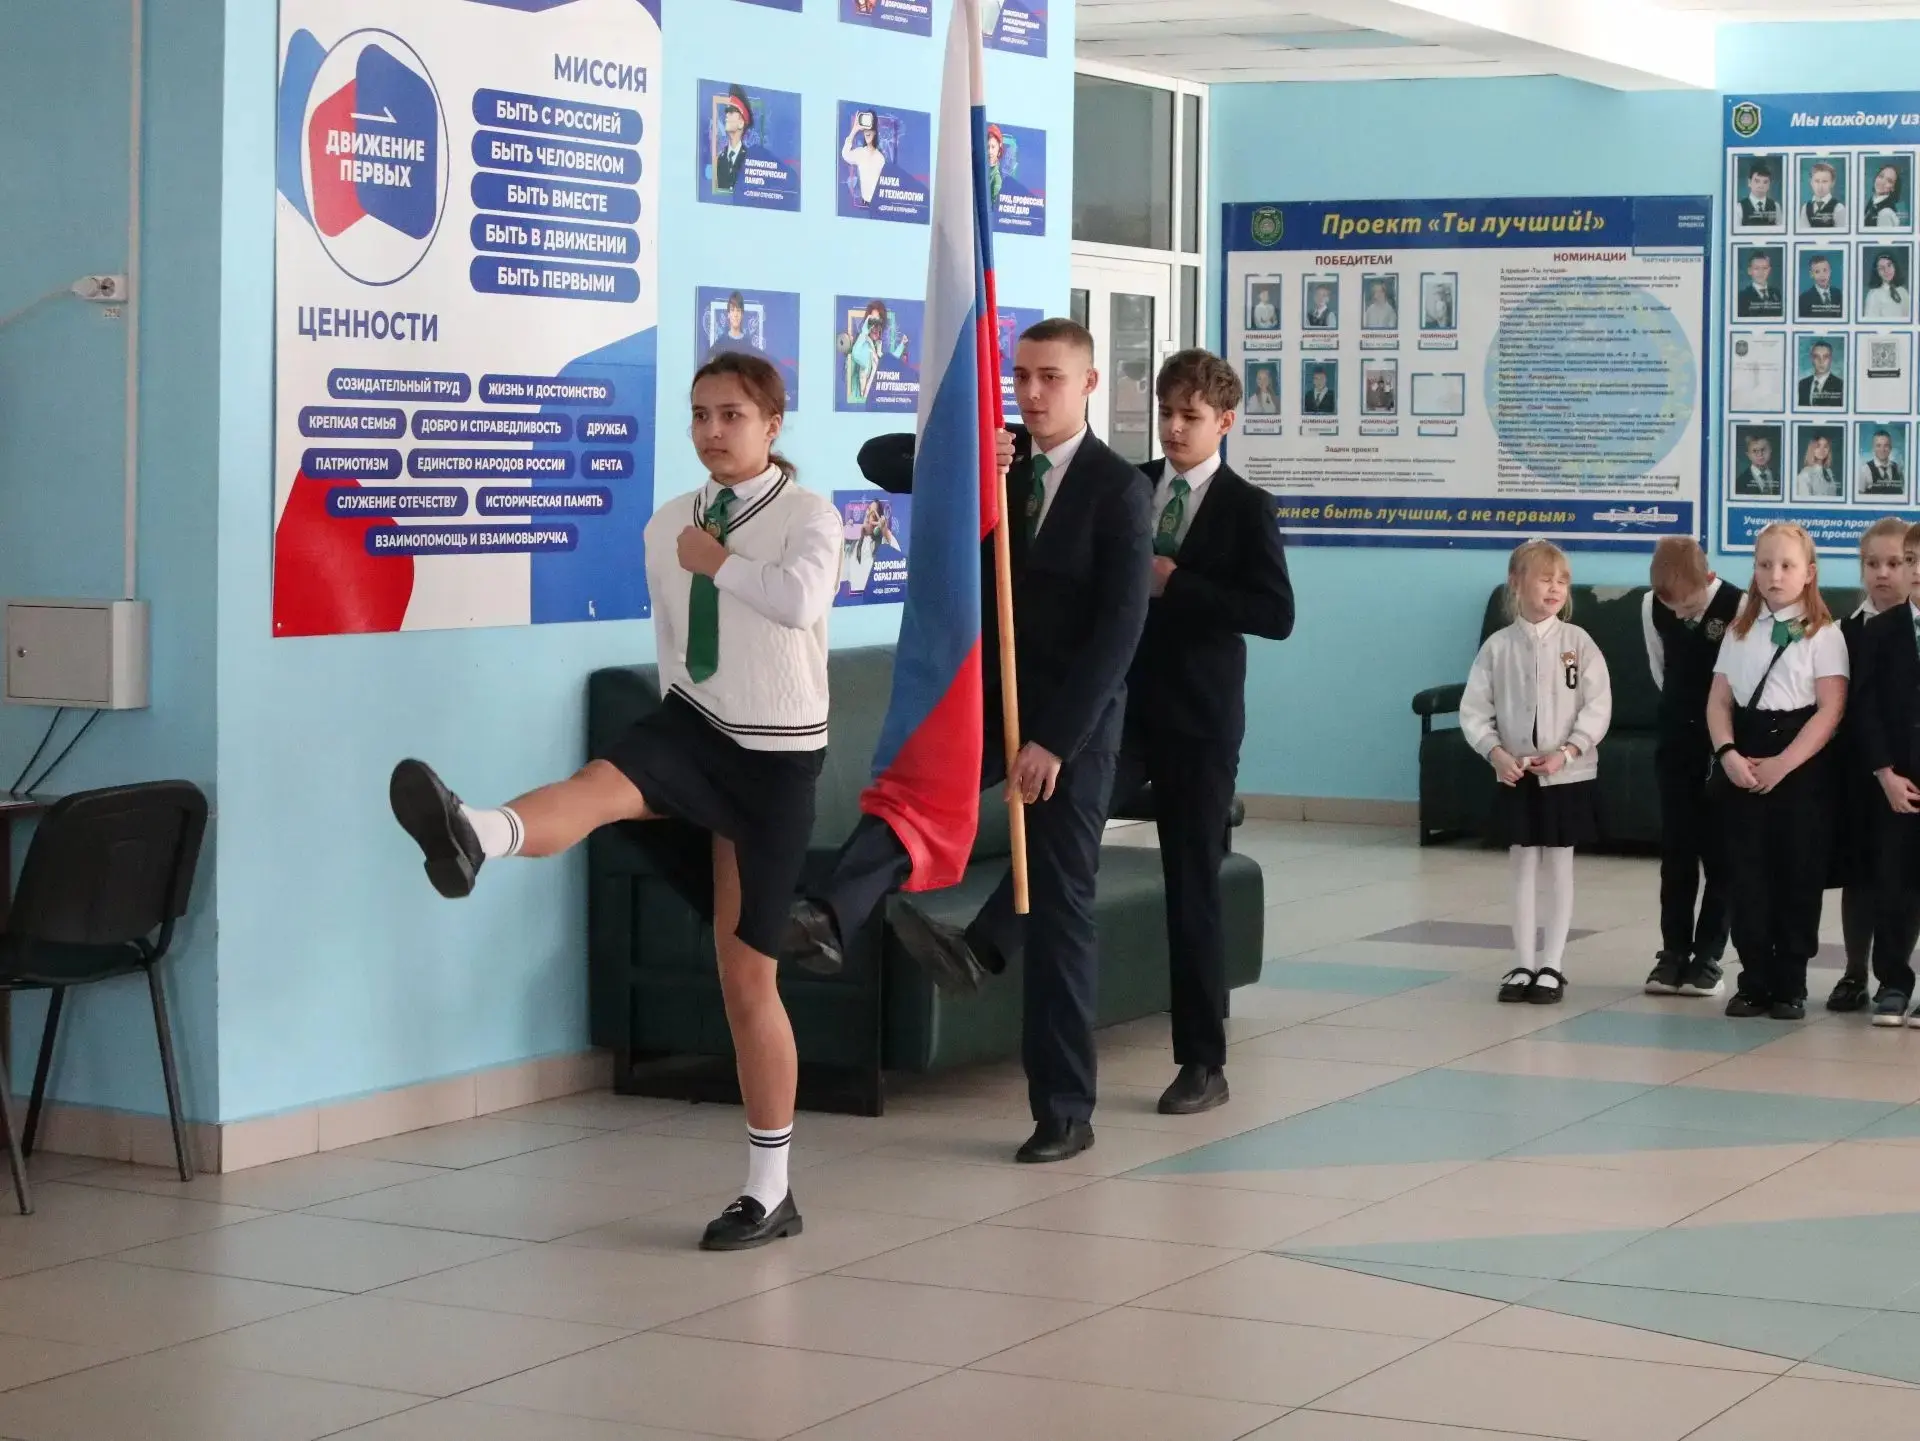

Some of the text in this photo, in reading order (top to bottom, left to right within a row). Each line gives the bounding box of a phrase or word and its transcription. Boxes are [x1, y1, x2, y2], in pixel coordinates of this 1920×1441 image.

[554, 53, 647, 93] МИССИЯ
[496, 100, 622, 135] БЫТЬ С РОССИЕЙ
[1790, 112, 1819, 127] Мы
[1822, 111, 1898, 128] каждому
[325, 129, 425, 162] ДВИЖЕНИЕ
[491, 141, 624, 174] БЫТЬ ЧЕЛОВЕКОМ
[340, 159, 412, 188] ПЕРВЫХ
[880, 176, 900, 187] НАУКА
[507, 184, 608, 213] БЫТЬ ВМЕСТЕ
[879, 189, 924, 201] И ТЕХНОЛОГИИ
[1322, 210, 1605, 239] Проект «Ты лучший!»
[485, 224, 627, 254] БЫТЬ В ДВИЖЕНИИ
[1315, 255, 1393, 267] ПОБЕДИТЕЛИ
[1553, 252, 1627, 263] НОМИНАЦИИ
[497, 266, 615, 293] БЫТЬ ПЕРВЫМИ
[298, 306, 439, 342] ЦЕННОСТИ
[877, 371, 900, 380] ТУРИЗМ
[336, 376, 461, 397] СОЗИДАТЕЛЬНЫЙ ТРУД
[488, 381, 607, 400] ЖИЗНЬ И ДОСТОИНСТВО
[309, 415, 397, 431] КРЕПКАЯ СЕМЬЯ
[421, 418, 562, 436] ДОБРО И СПРАВЕДЛИВОСТЬ
[587, 422, 628, 437] ДРУЖБА
[315, 456, 389, 471] ПАТРИОТИЗМ
[417, 457, 566, 472] ЕДИНСТВО НАРОДОВ РОССИИ
[591, 458, 623, 472] МЕЧТА
[337, 495, 457, 509] СЛУЖЕНИЕ ОТЕЧЕСТВУ
[485, 494, 603, 508] ИСТОРИЧЕСКАЯ ПАМЯТЬ
[1276, 507, 1320, 519] жнее
[1324, 504, 1373, 520] быть
[1376, 508, 1452, 524] лучшим,
[1457, 510, 1467, 521] а
[1471, 510, 1492, 521] не
[1495, 510, 1577, 525] первым»
[375, 531, 569, 549] ВЗАИМОПОМОЩЬ И ВЗАИМОВЫРУЧКА
[874, 558, 907, 571] ЗДОРОВЫЙ
[874, 572, 892, 582] ОБРАЗ
[1565, 665, 1578, 690] G
